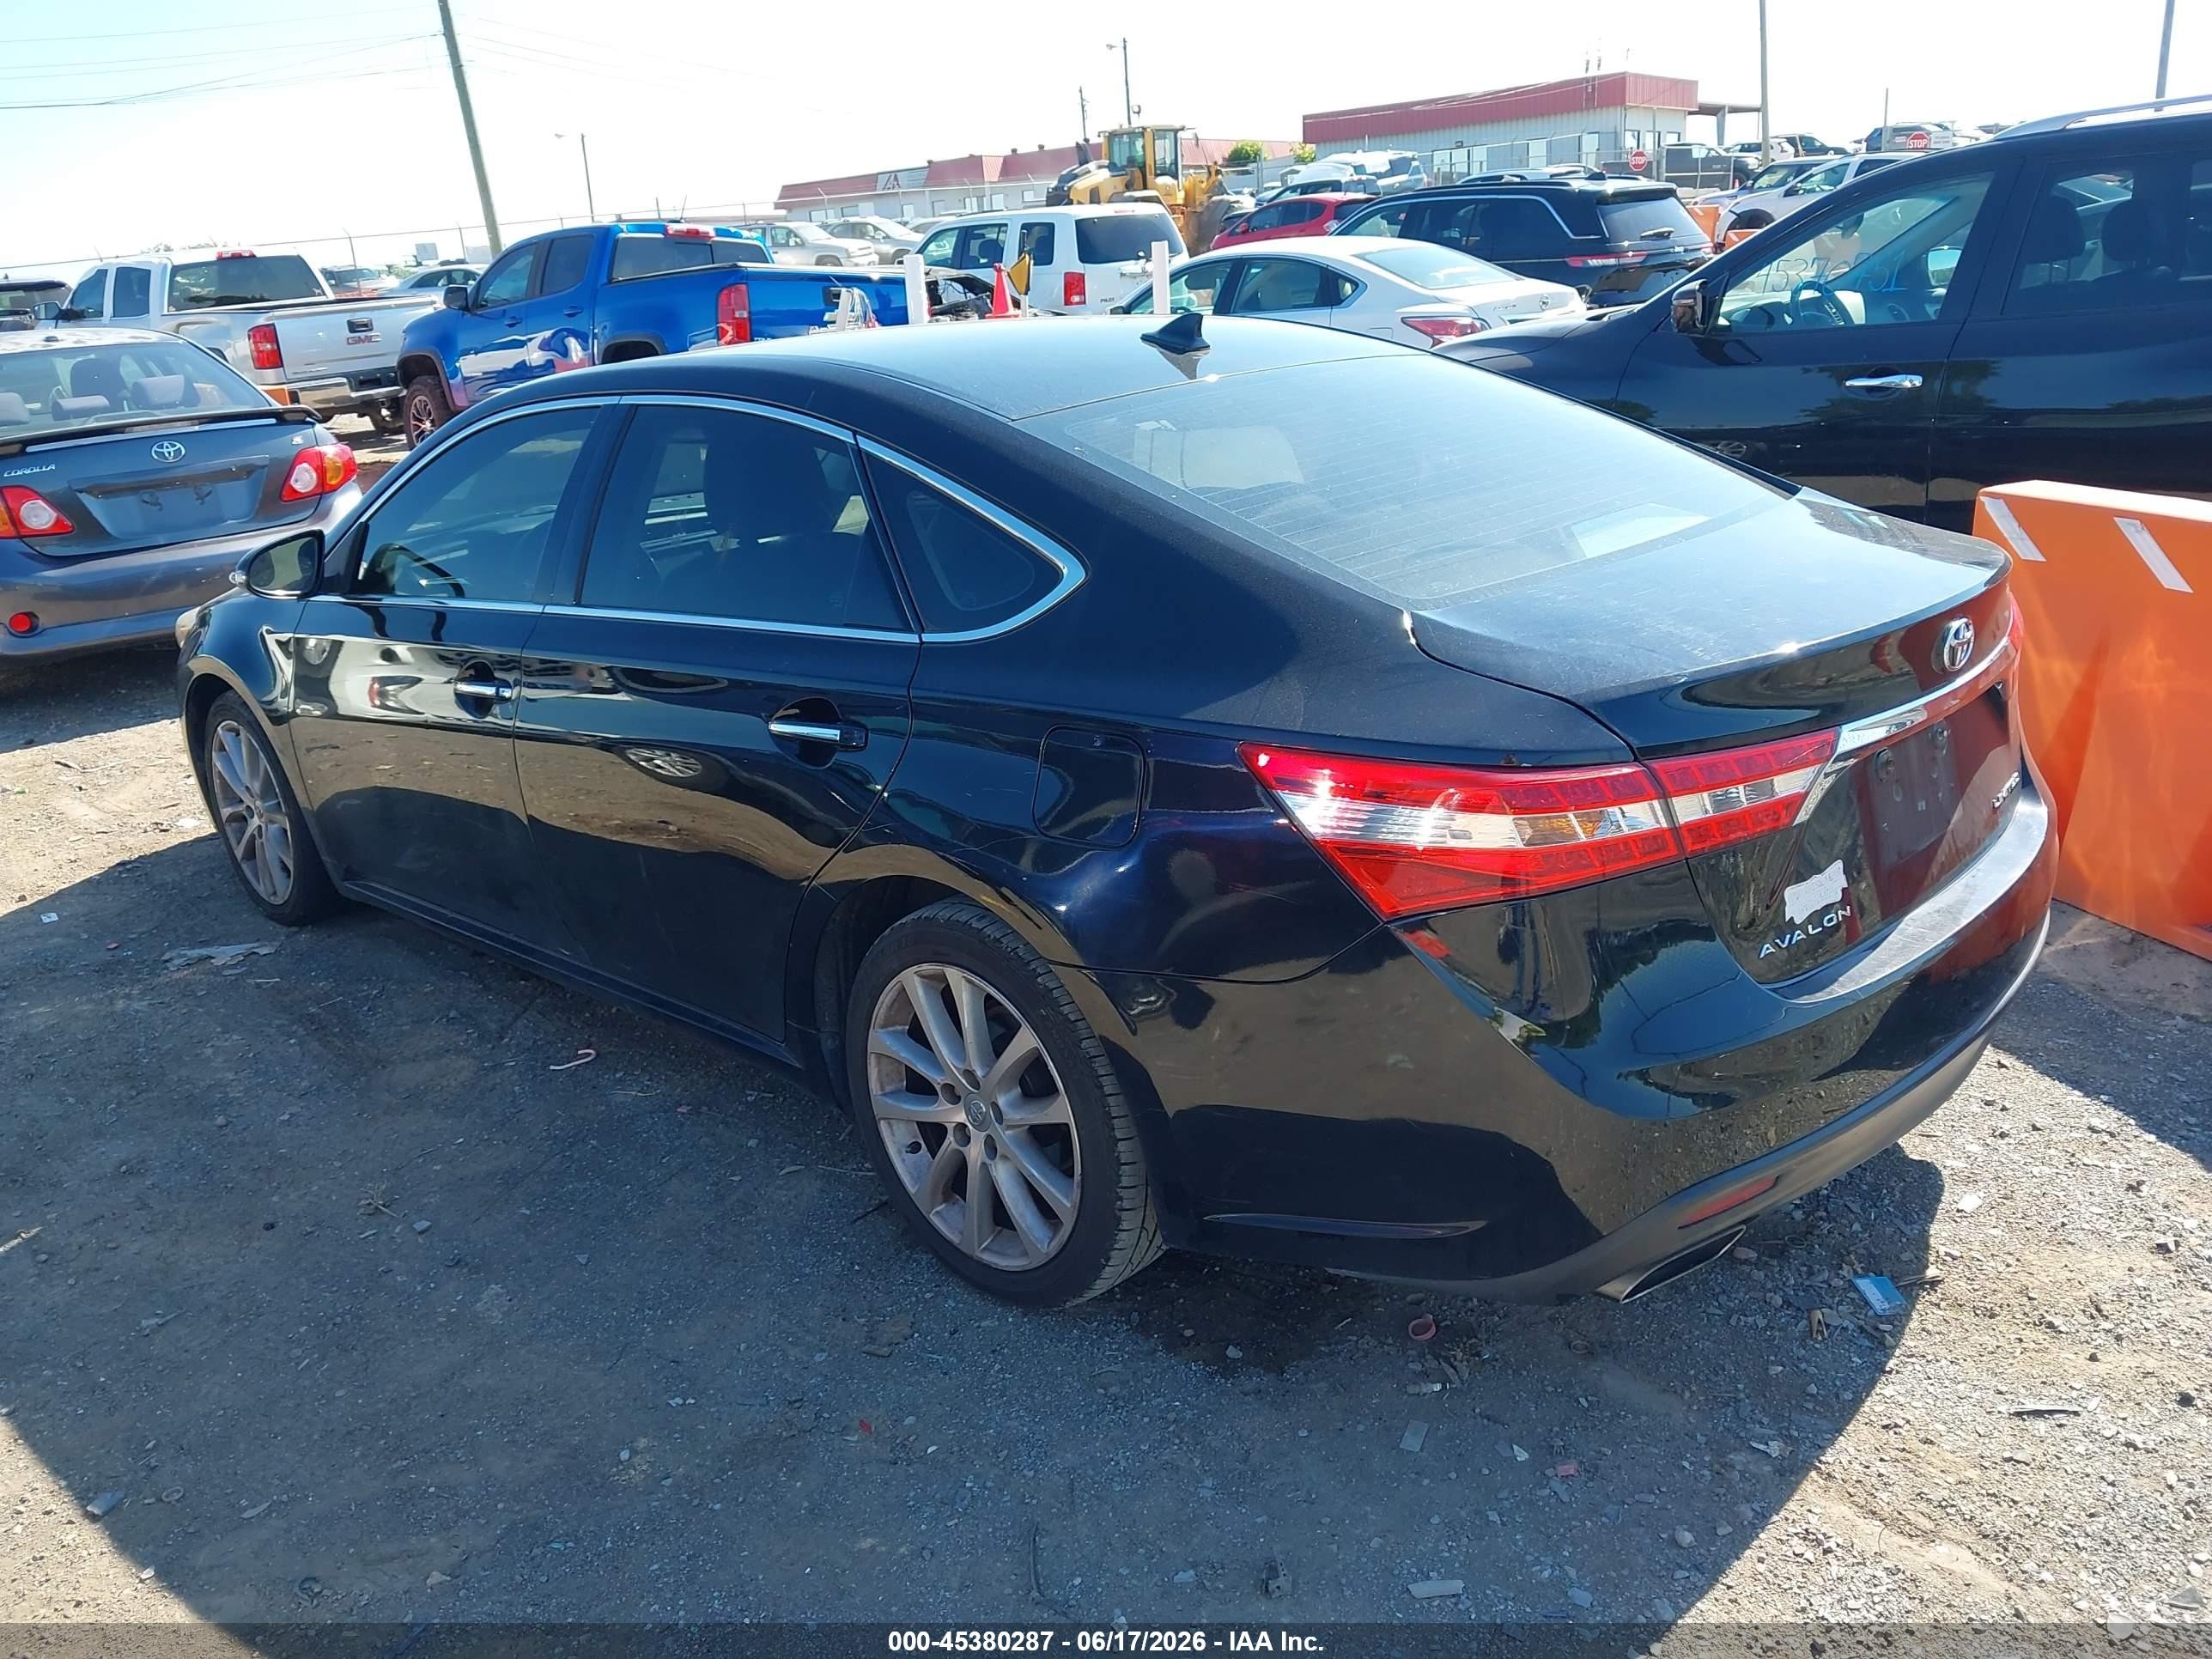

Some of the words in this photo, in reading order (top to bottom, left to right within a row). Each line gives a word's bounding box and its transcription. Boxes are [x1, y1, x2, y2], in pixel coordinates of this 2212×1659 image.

[1909, 138, 1928, 149] STOP
[1631, 156, 1646, 165] STOP
[346, 332, 382, 345] GMC
[3, 464, 56, 477] COROLLA
[1759, 905, 1851, 959] AVALON
